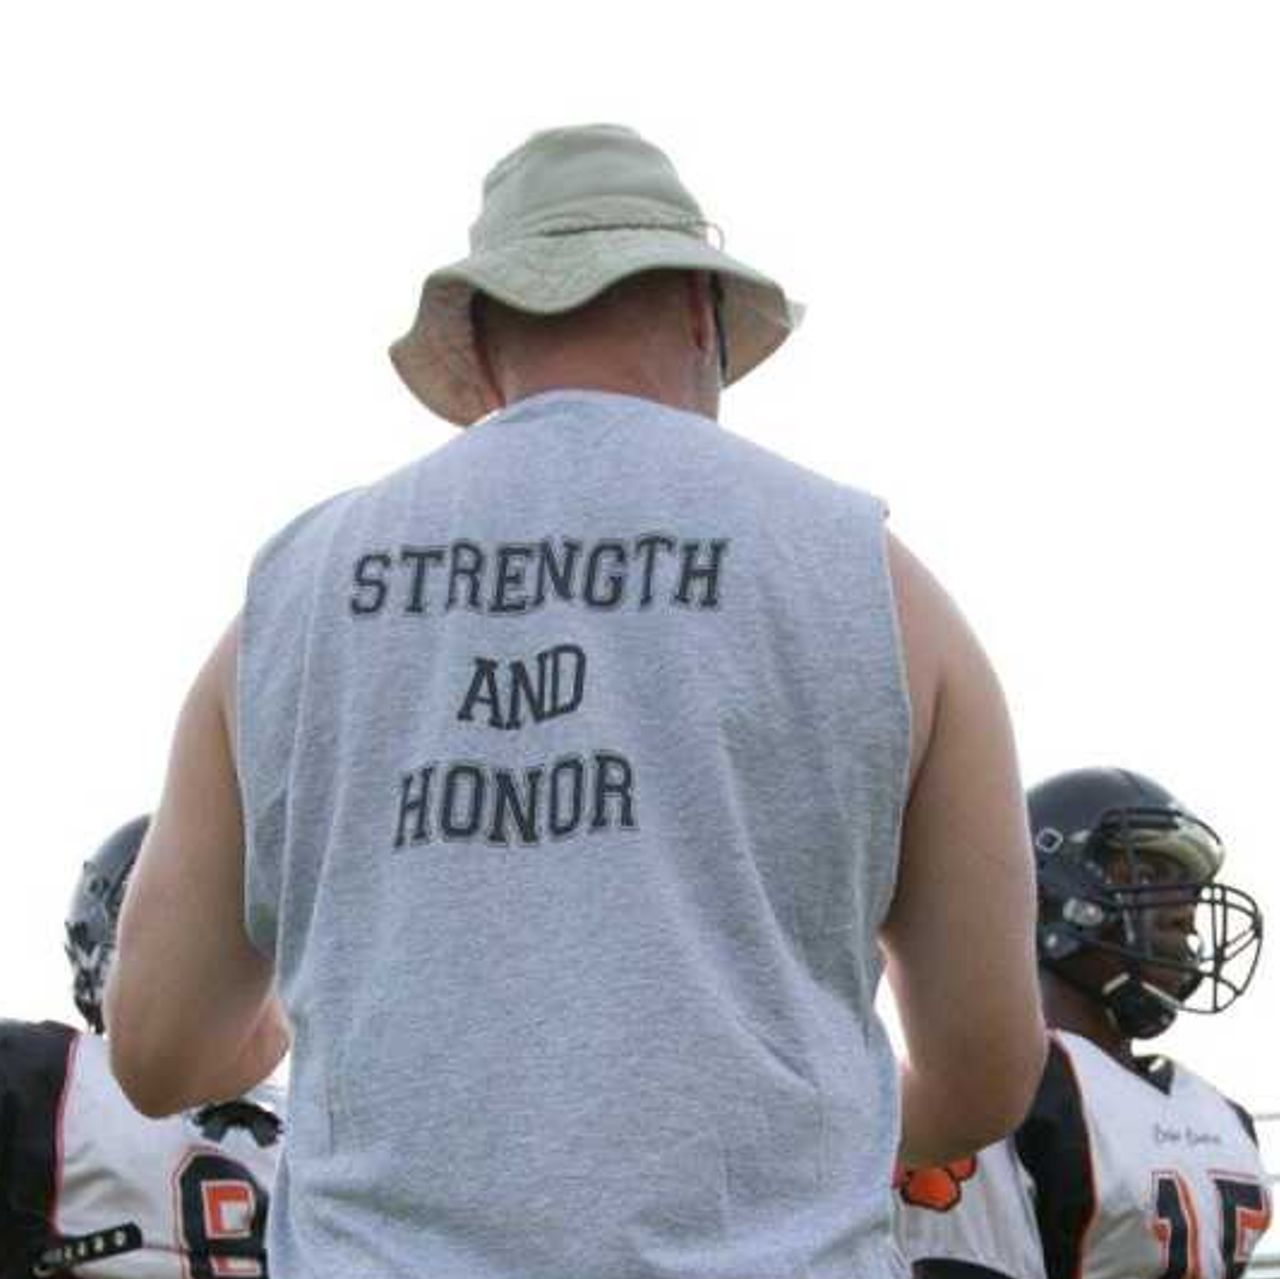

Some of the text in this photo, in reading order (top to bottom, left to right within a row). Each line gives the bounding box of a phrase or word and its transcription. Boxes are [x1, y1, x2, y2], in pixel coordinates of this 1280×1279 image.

[350, 533, 732, 616] STRENGTH
[456, 643, 587, 730] AND
[394, 752, 637, 848] HONOR
